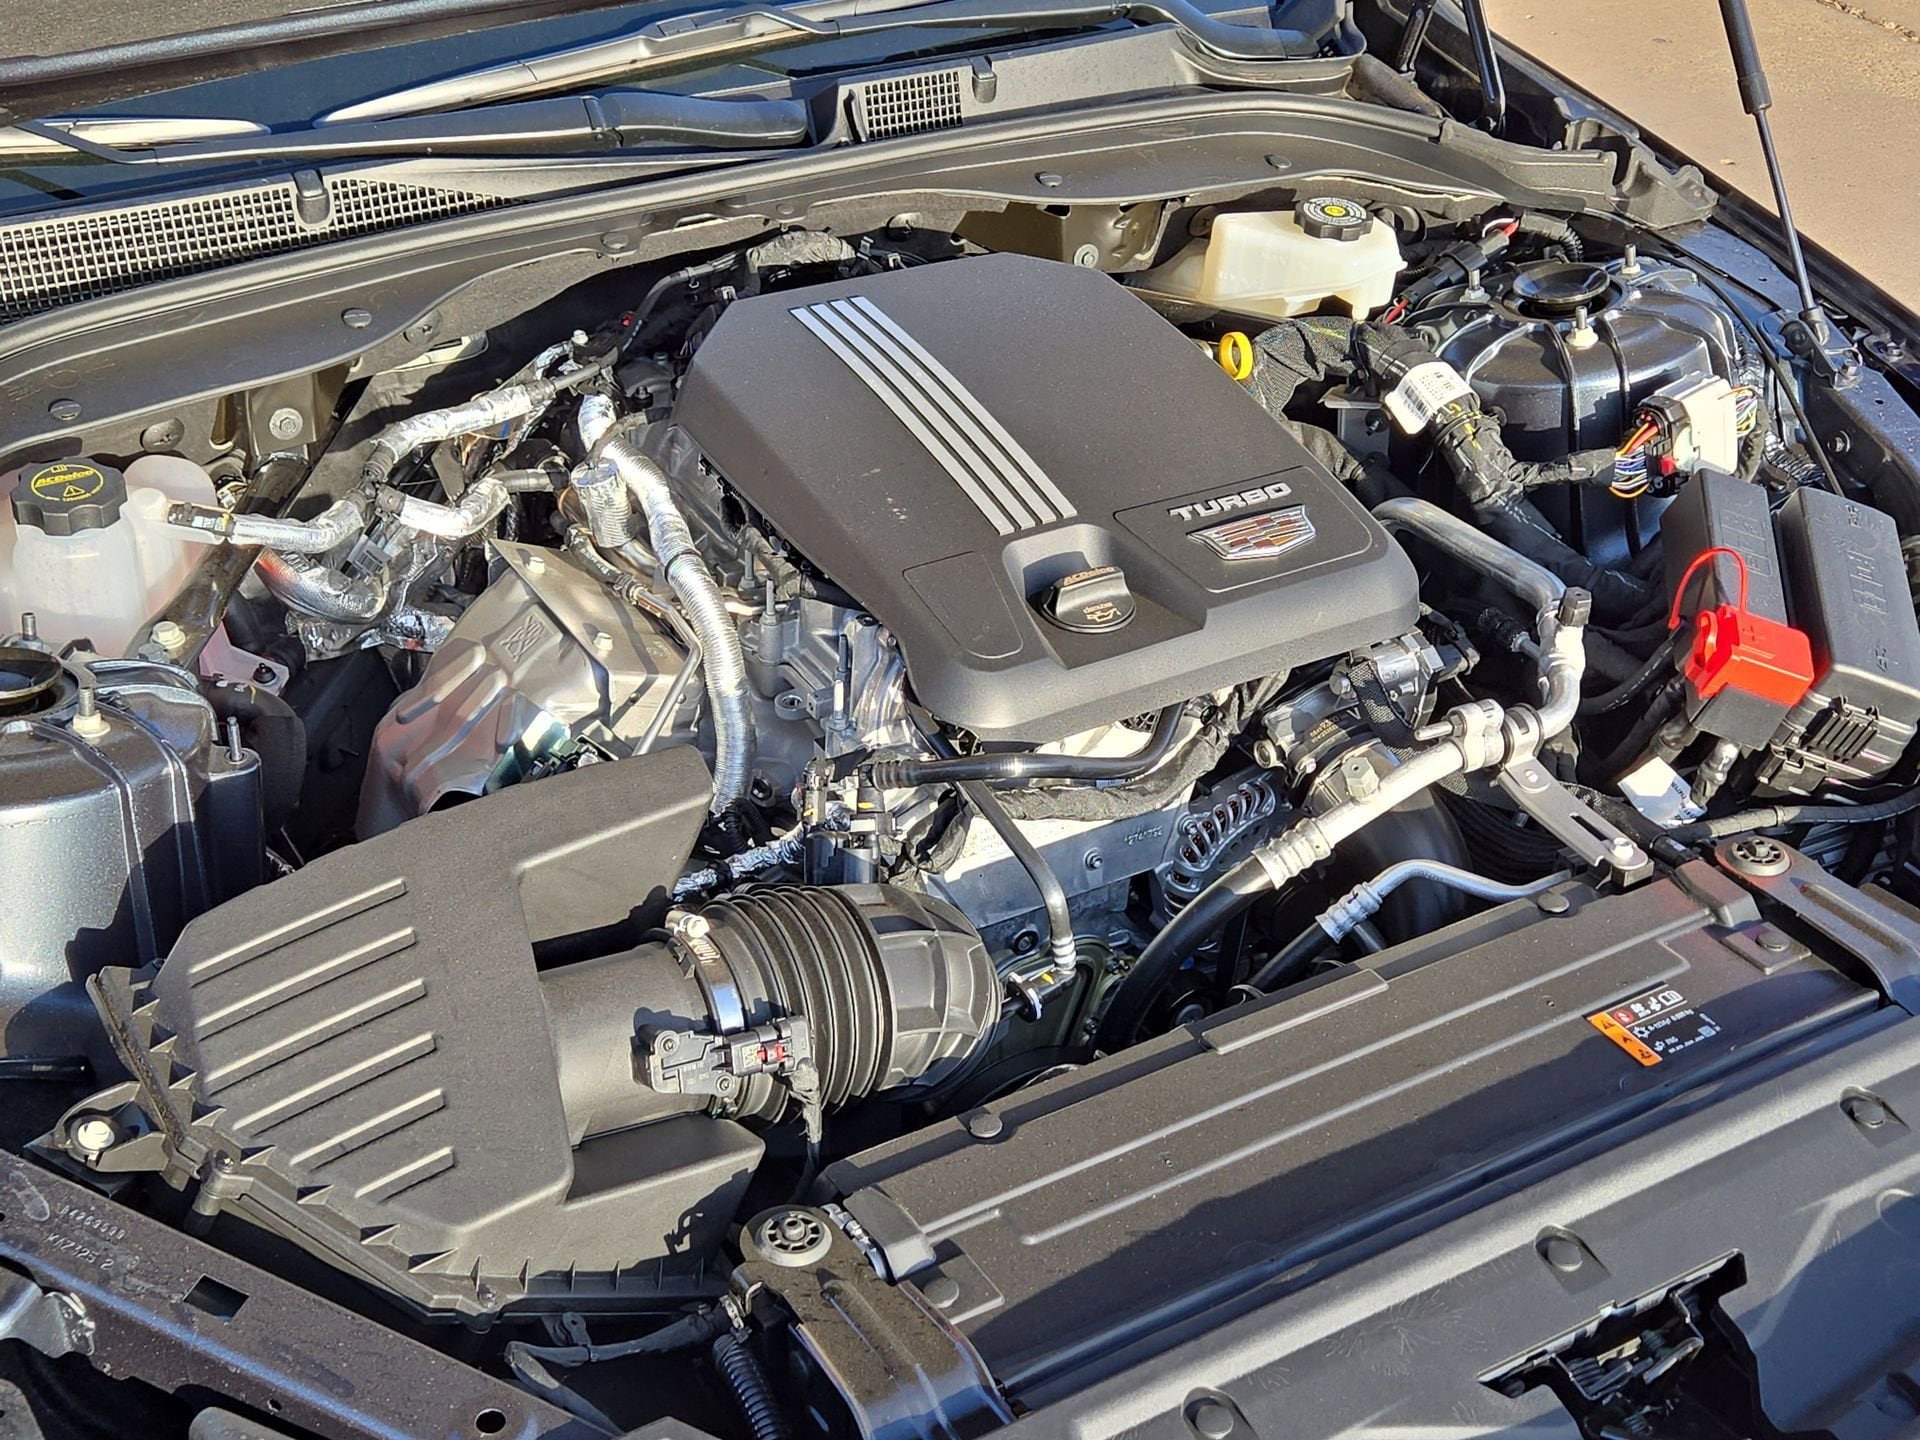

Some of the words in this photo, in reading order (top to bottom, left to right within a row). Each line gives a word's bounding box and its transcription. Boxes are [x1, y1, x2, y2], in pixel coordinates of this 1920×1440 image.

[36, 470, 95, 488] ACDelco
[1168, 482, 1292, 521] TURBO
[1063, 566, 1116, 586] ACDelco
